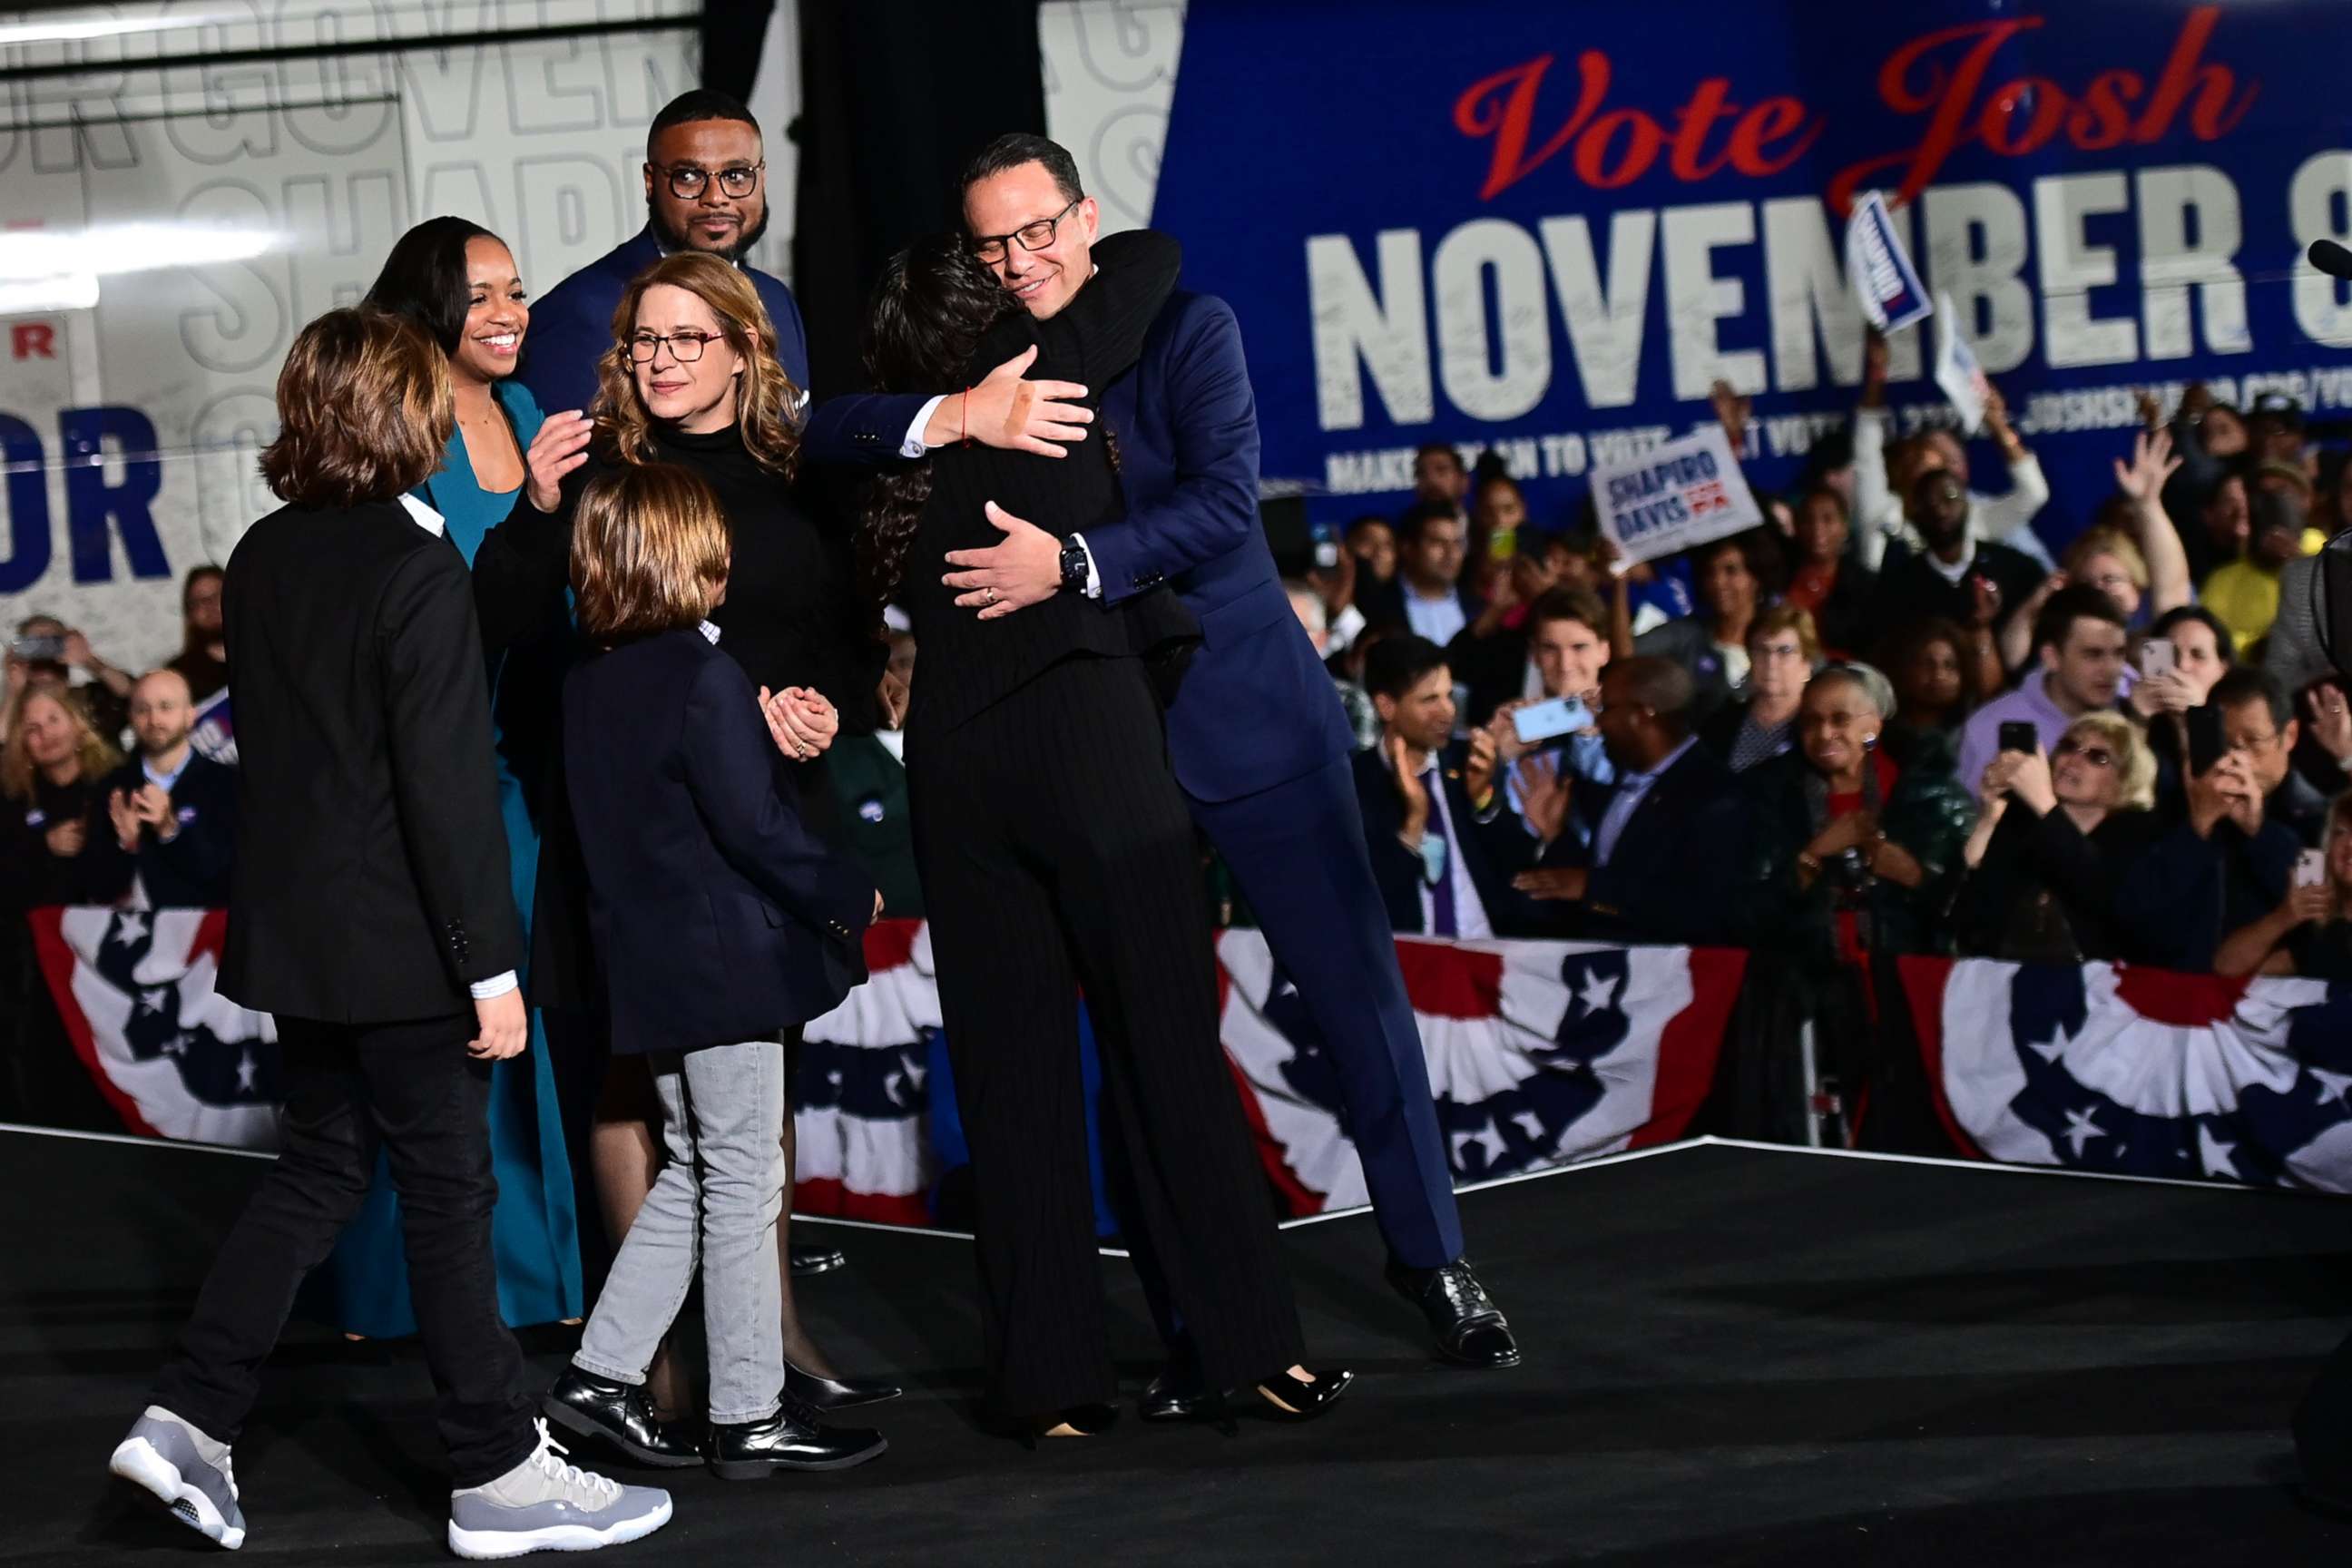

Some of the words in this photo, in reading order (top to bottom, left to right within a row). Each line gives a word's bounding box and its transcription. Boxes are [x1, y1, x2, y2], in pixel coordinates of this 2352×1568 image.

[1454, 49, 1822, 201] Vote
[1826, 5, 2260, 218] Josh
[1306, 162, 2253, 431] NOVEMBER
